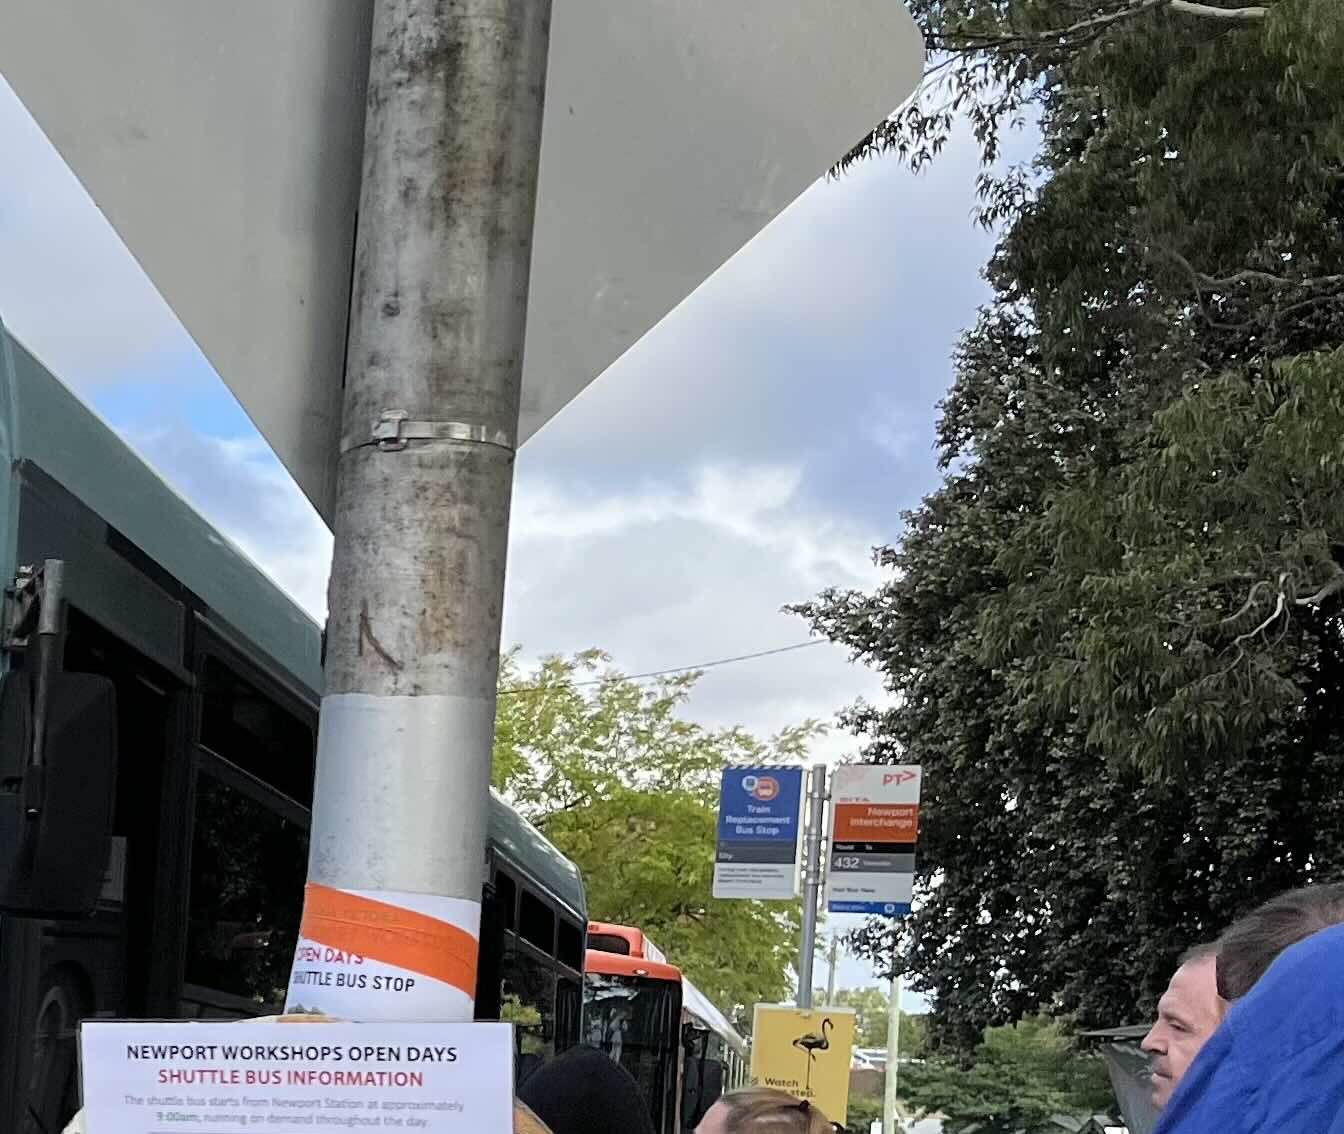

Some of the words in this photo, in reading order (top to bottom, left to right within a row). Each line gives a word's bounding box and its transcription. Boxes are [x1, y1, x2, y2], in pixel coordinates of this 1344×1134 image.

[747, 805, 771, 814] Train
[868, 808, 913, 818] Newport
[725, 816, 791, 826] Replacement
[736, 826, 753, 834] Bus
[756, 826, 779, 836] Stop
[833, 856, 860, 869] 432
[325, 948, 364, 965] DAYS
[336, 973, 367, 988] BUS
[373, 975, 415, 992] STOP
[126, 1045, 217, 1061] NEWPORT
[222, 1045, 343, 1062] WORKSHOPS
[349, 1046, 401, 1062] OPEN
[407, 1046, 458, 1063] DAYS
[158, 1069, 240, 1084] SHUTTLE
[245, 1070, 282, 1085] BUS
[287, 1070, 424, 1087] INFORMATION
[765, 1077, 799, 1088] Watch
[124, 1095, 144, 1105] The
[147, 1095, 183, 1105] shuttle
[187, 1095, 206, 1106] bus
[209, 1096, 240, 1106] starts
[272, 1096, 321, 1109] Newport
[324, 1097, 364, 1109] Station
[381, 1099, 464, 1112] approximately
[204, 1113, 247, 1125] running
[267, 1113, 313, 1124] demand
[316, 1115, 380, 1127] throughout
[383, 1116, 403, 1126] the
